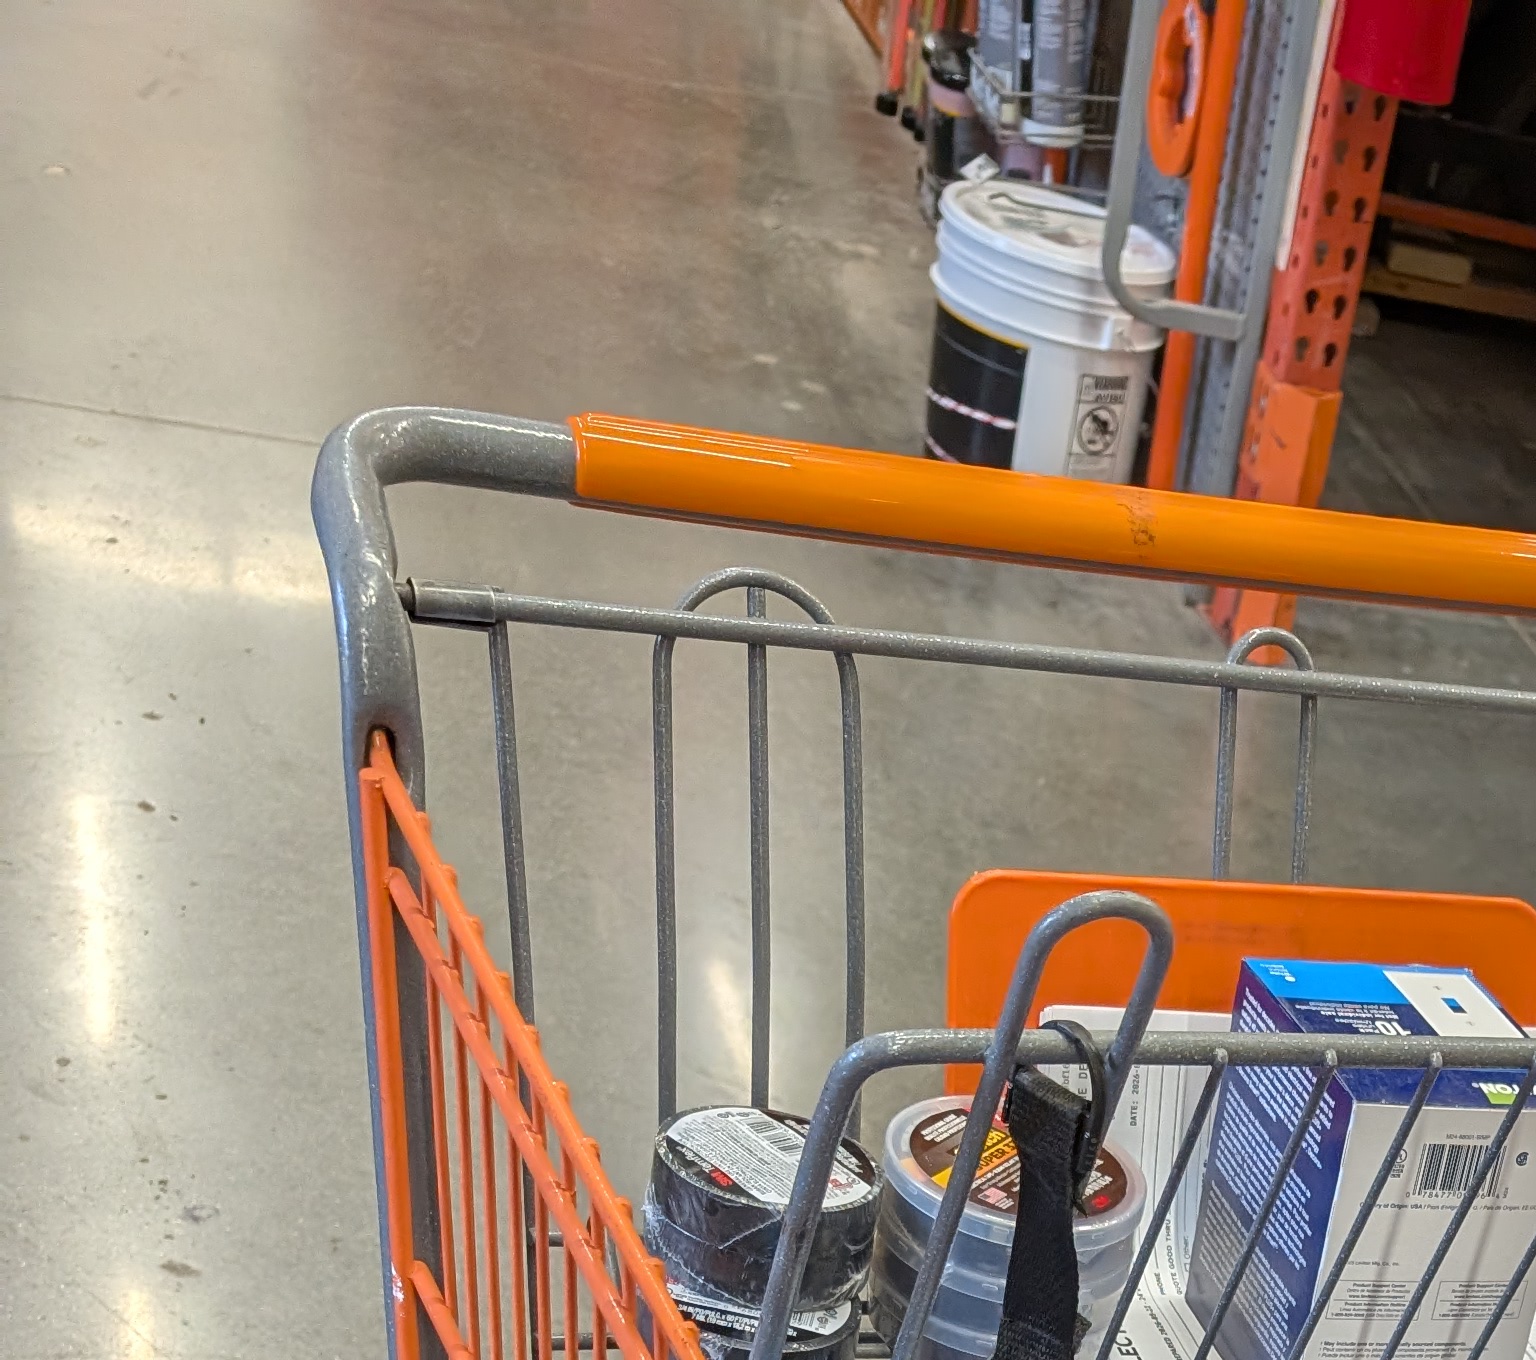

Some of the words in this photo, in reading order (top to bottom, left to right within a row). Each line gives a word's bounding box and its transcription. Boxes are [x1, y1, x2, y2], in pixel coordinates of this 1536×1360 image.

[1372, 1020, 1415, 1036] 10
[1131, 1064, 1142, 1096] 2026-
[1129, 1099, 1138, 1126] DATE:
[1172, 1272, 1182, 1294] QUOTE
